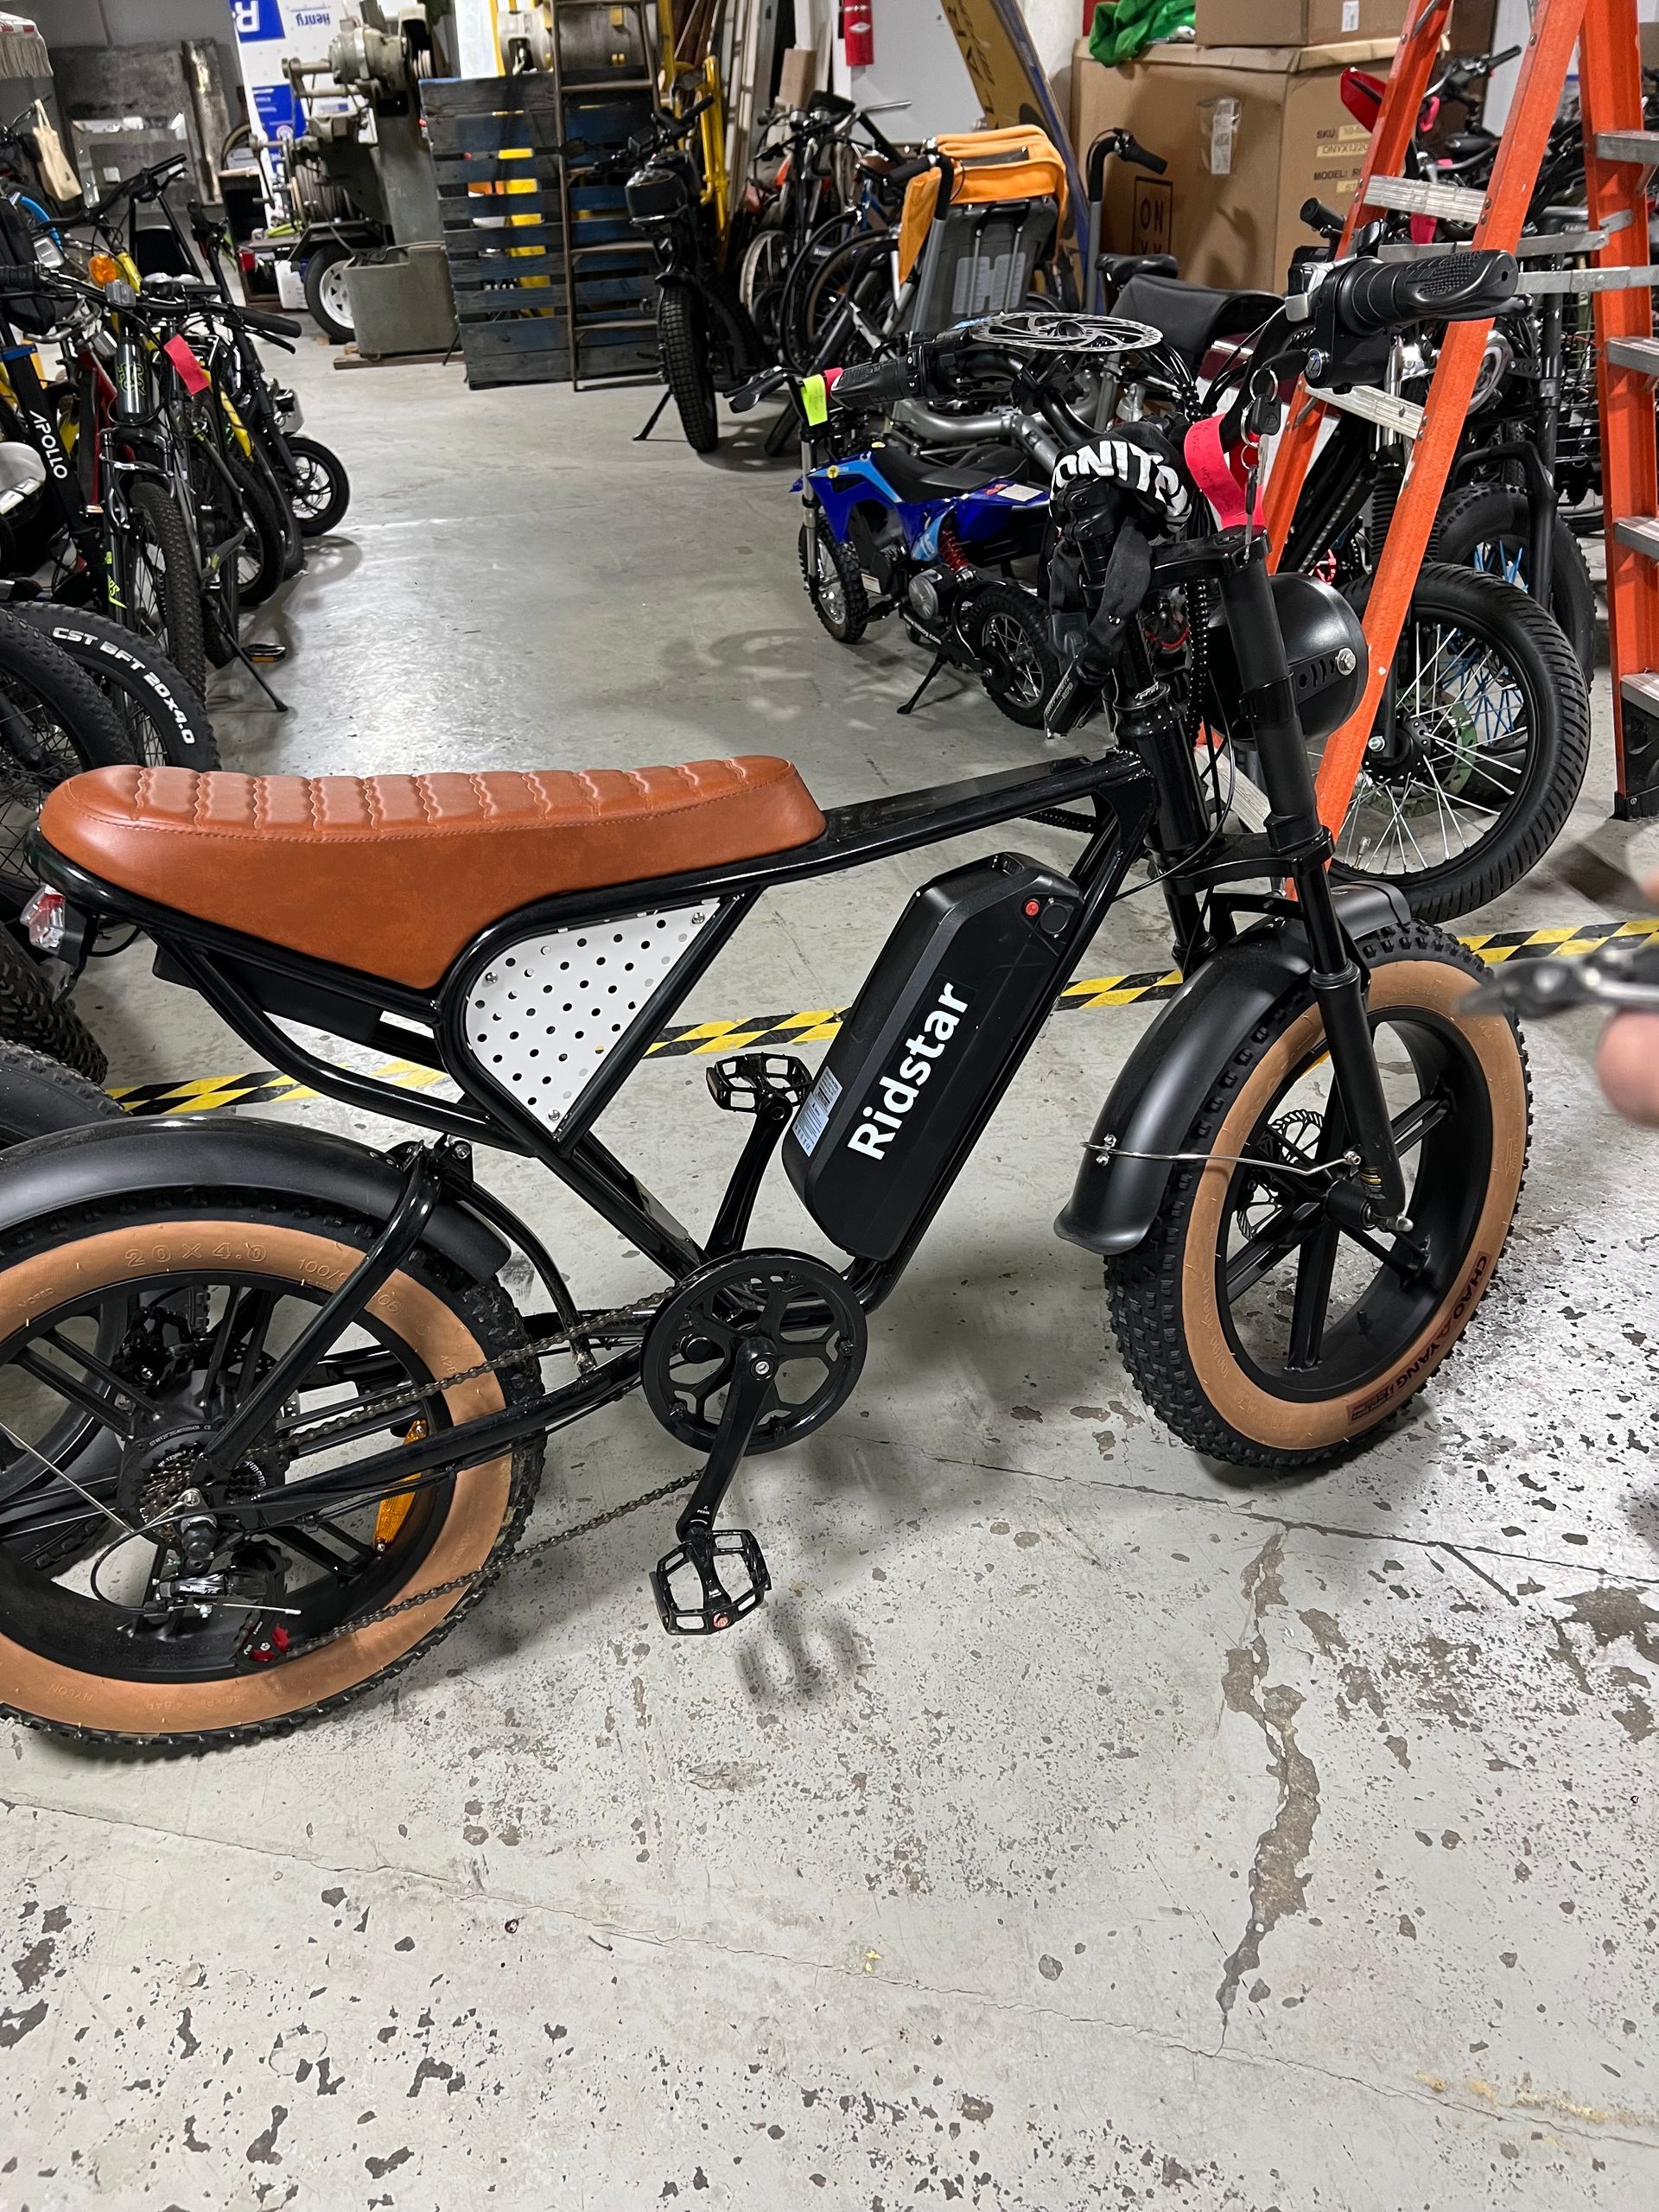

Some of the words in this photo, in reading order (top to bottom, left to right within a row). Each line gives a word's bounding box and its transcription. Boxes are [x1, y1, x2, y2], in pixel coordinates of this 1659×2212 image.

[296, 11, 331, 27] Henry
[29, 410, 68, 480] APOLLO
[52, 626, 99, 645] CST
[99, 640, 146, 671] BFT
[847, 982, 969, 1160] Ridstar
[1452, 1255, 1487, 1321] CHAO
[1395, 1341, 1442, 1389] YANG
